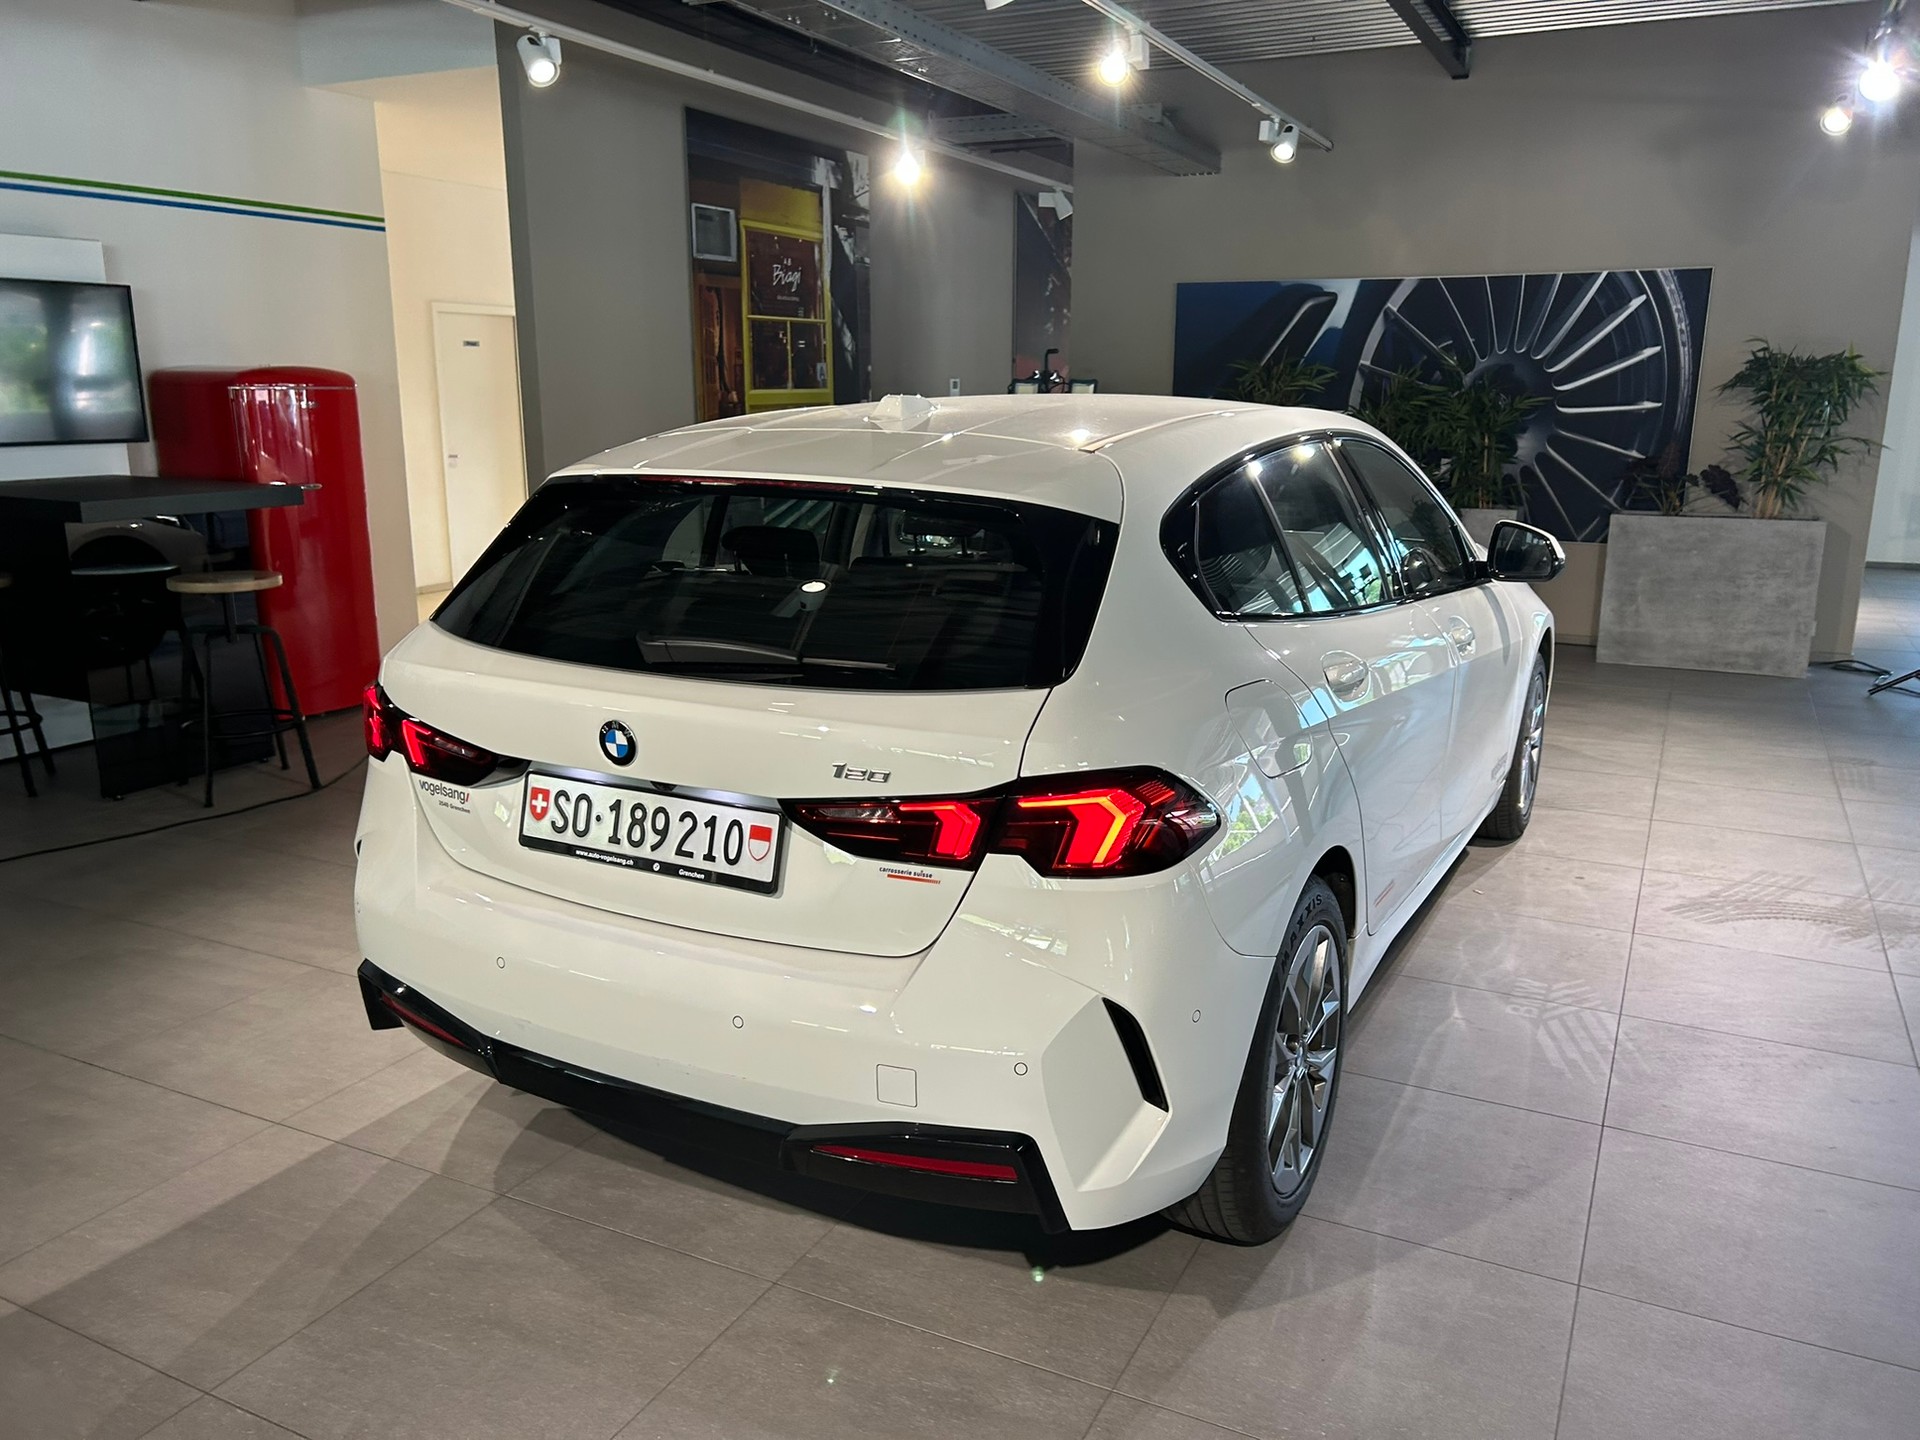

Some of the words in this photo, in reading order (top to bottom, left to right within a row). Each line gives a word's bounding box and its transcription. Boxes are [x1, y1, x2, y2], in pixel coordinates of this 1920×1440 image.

[832, 762, 892, 783] 120
[575, 849, 634, 866] www.auto-vogelsang.ch
[678, 868, 705, 880] Grenchen
[879, 866, 912, 876] carrosserie
[913, 870, 933, 879] suisse
[1280, 894, 1323, 974] MAXXIS
